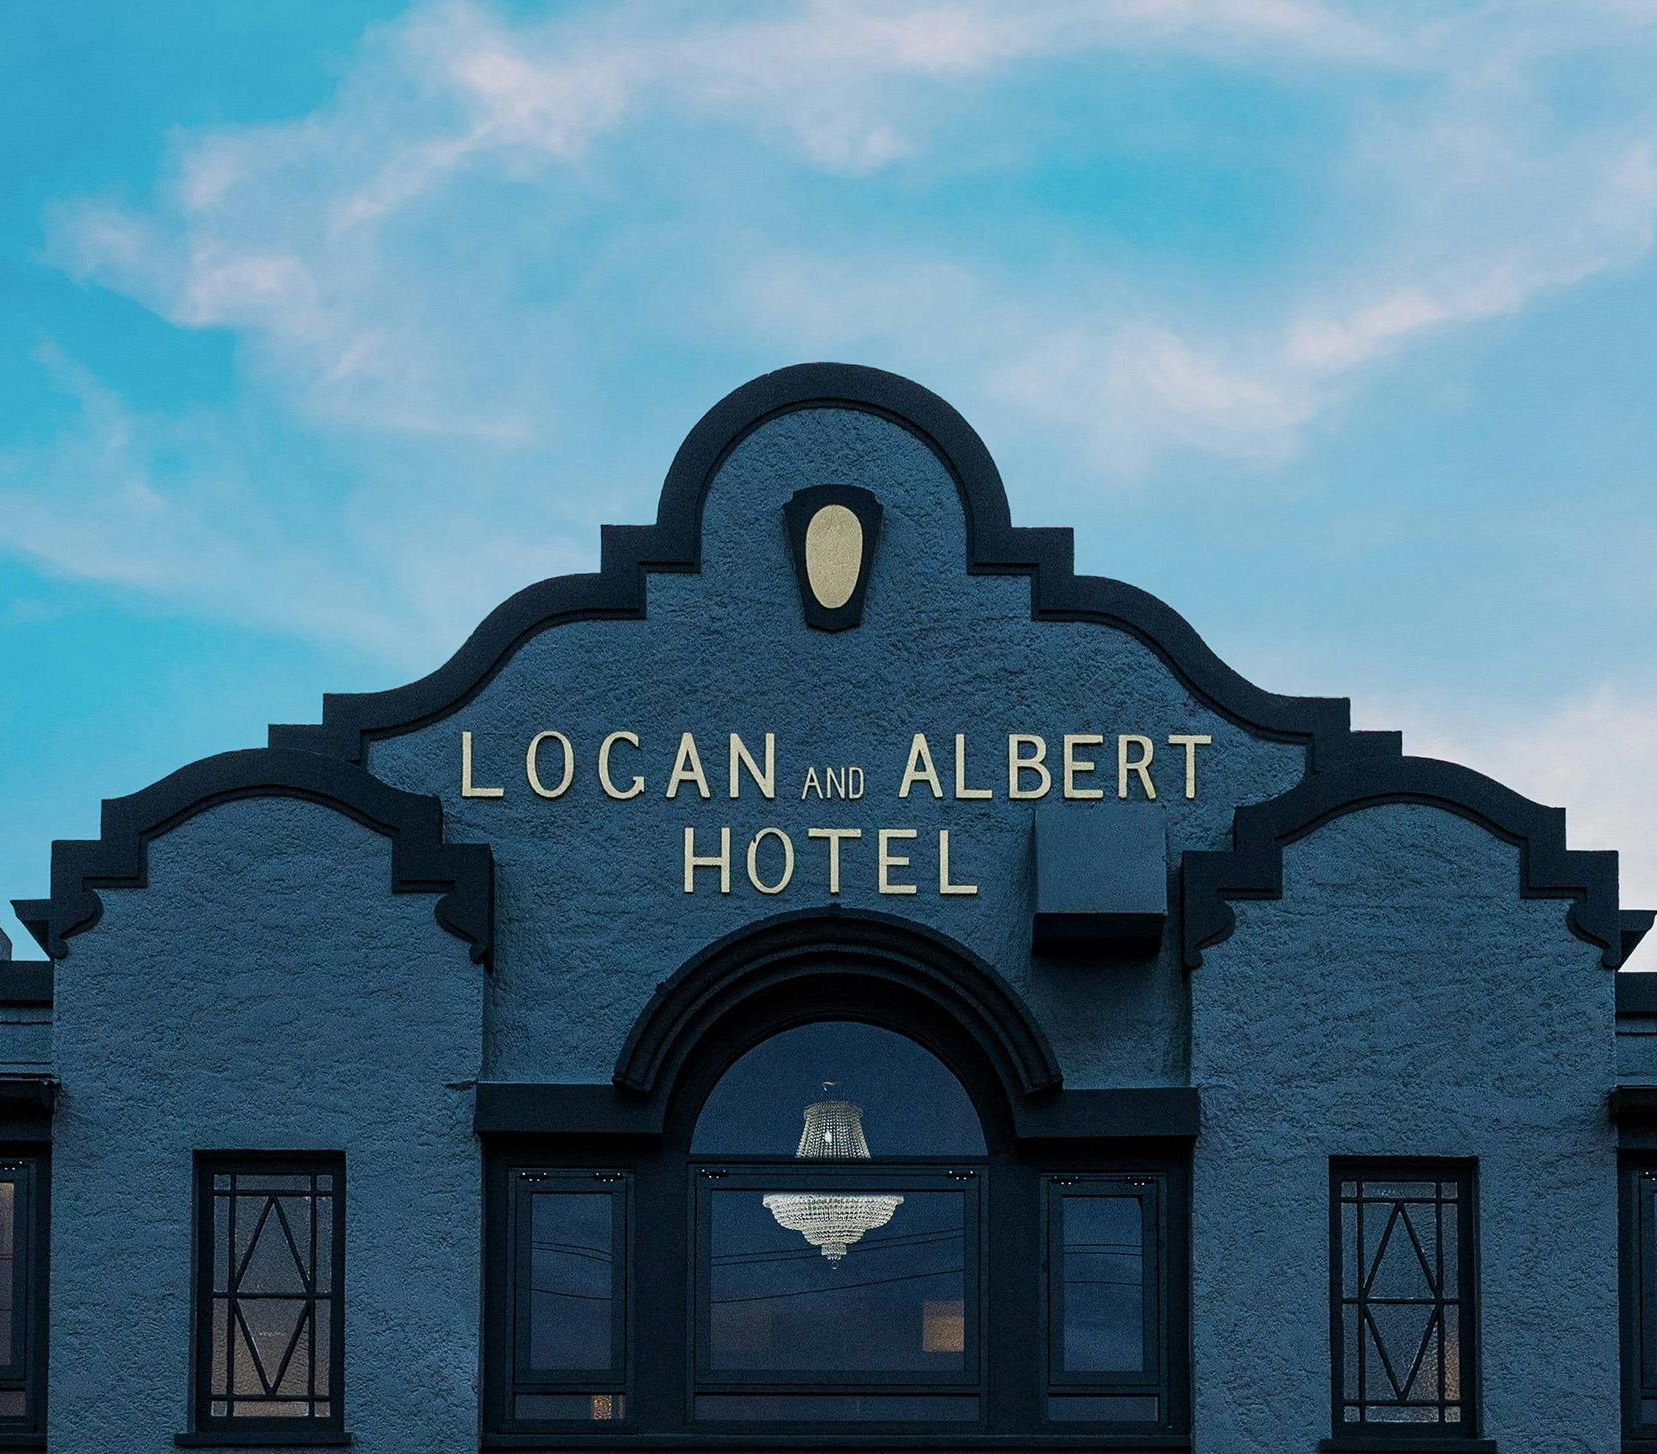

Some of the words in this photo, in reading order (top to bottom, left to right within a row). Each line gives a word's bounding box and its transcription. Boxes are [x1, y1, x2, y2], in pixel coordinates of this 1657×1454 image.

[460, 730, 776, 799] LOGAN
[801, 766, 866, 800] AND
[898, 732, 1213, 800] ALBERT
[683, 827, 979, 895] HOTEL
